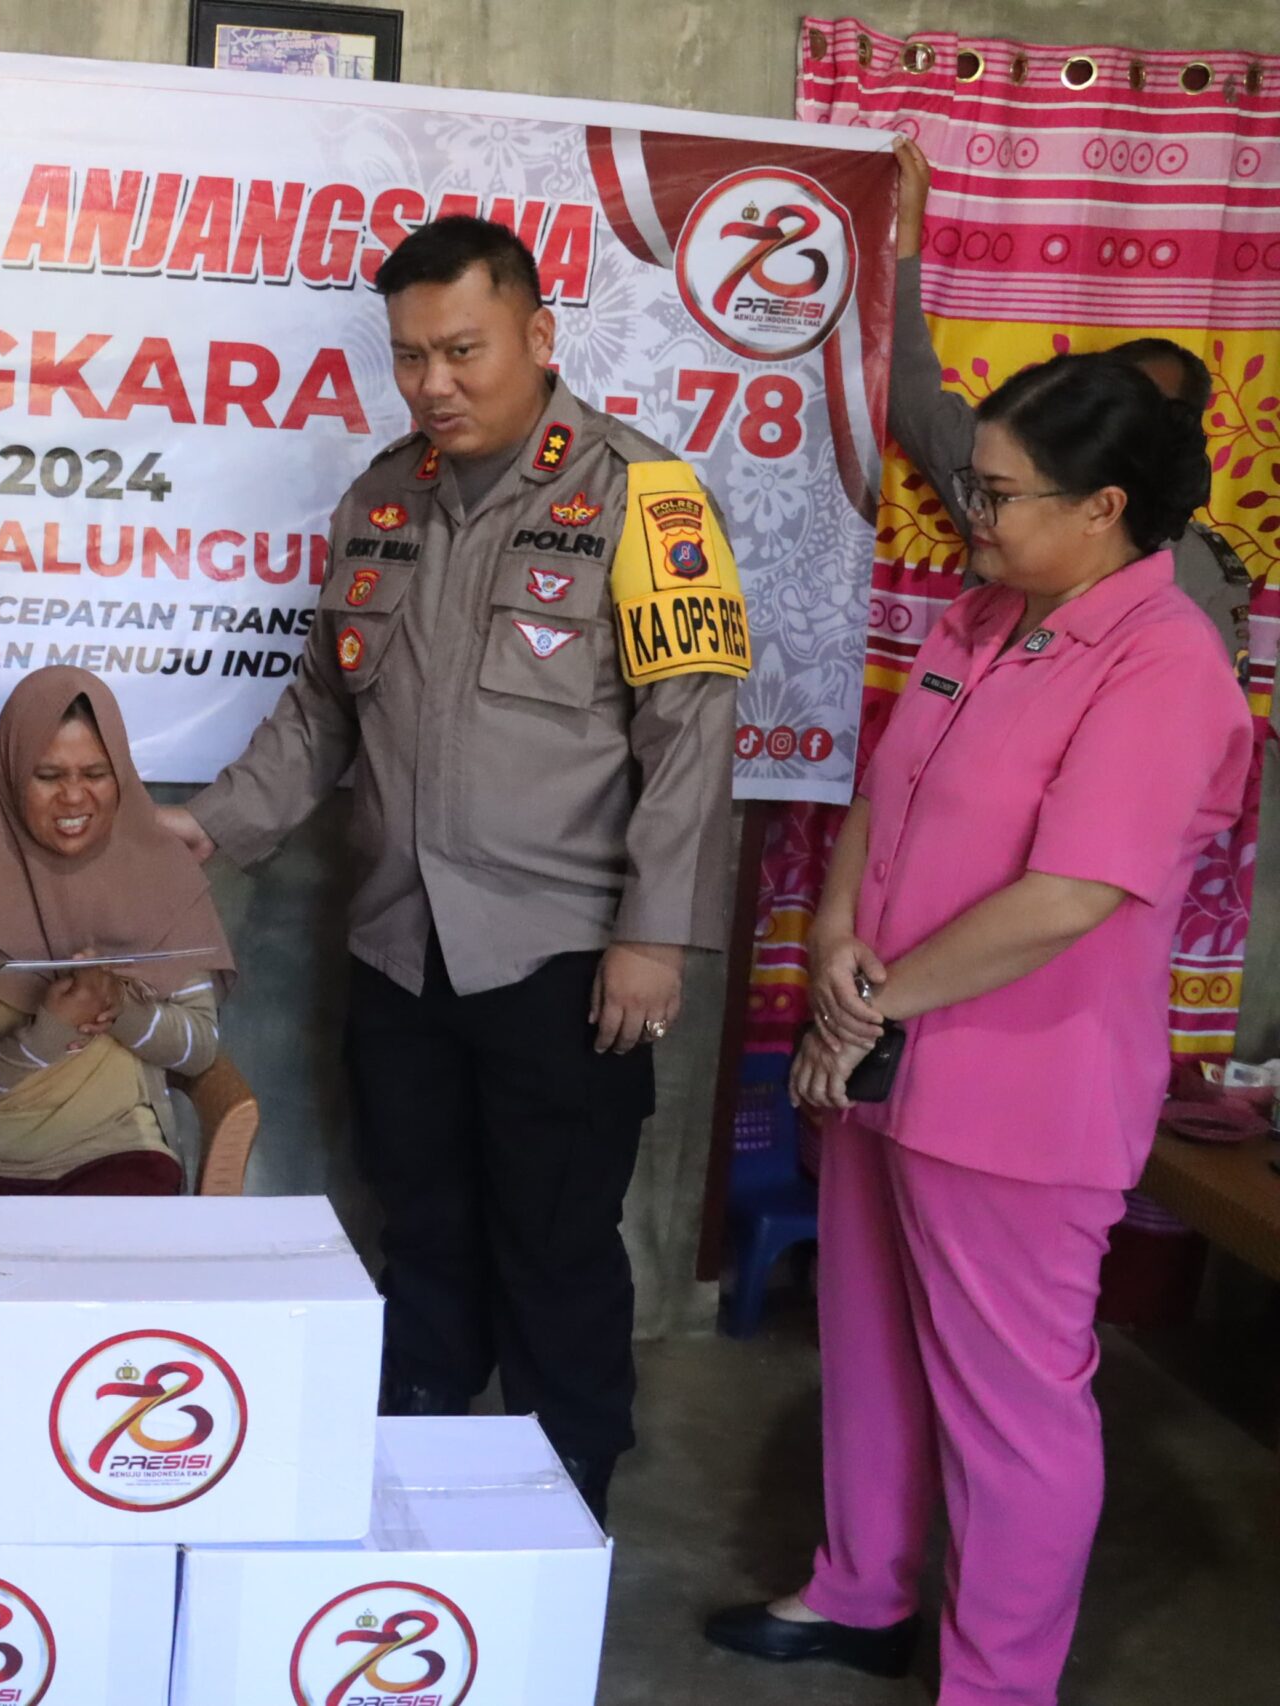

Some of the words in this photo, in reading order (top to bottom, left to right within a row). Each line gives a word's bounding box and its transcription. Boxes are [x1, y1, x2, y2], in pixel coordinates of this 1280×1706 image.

[734, 297, 826, 319] PRESISI
[734, 314, 763, 323] MENUJU
[765, 316, 802, 326] INDONESIA
[804, 318, 821, 328] EMAS
[652, 500, 700, 514] POLRES
[513, 529, 606, 558] POLRI
[628, 602, 672, 666] KA
[672, 597, 719, 655] OPS
[718, 598, 747, 659] RES
[46, 644, 213, 677] MENUJU
[110, 1455, 213, 1470] PRESISI
[109, 1470, 141, 1478] MENUJU
[143, 1470, 185, 1478] INDONESIA
[187, 1470, 207, 1478] EMAS
